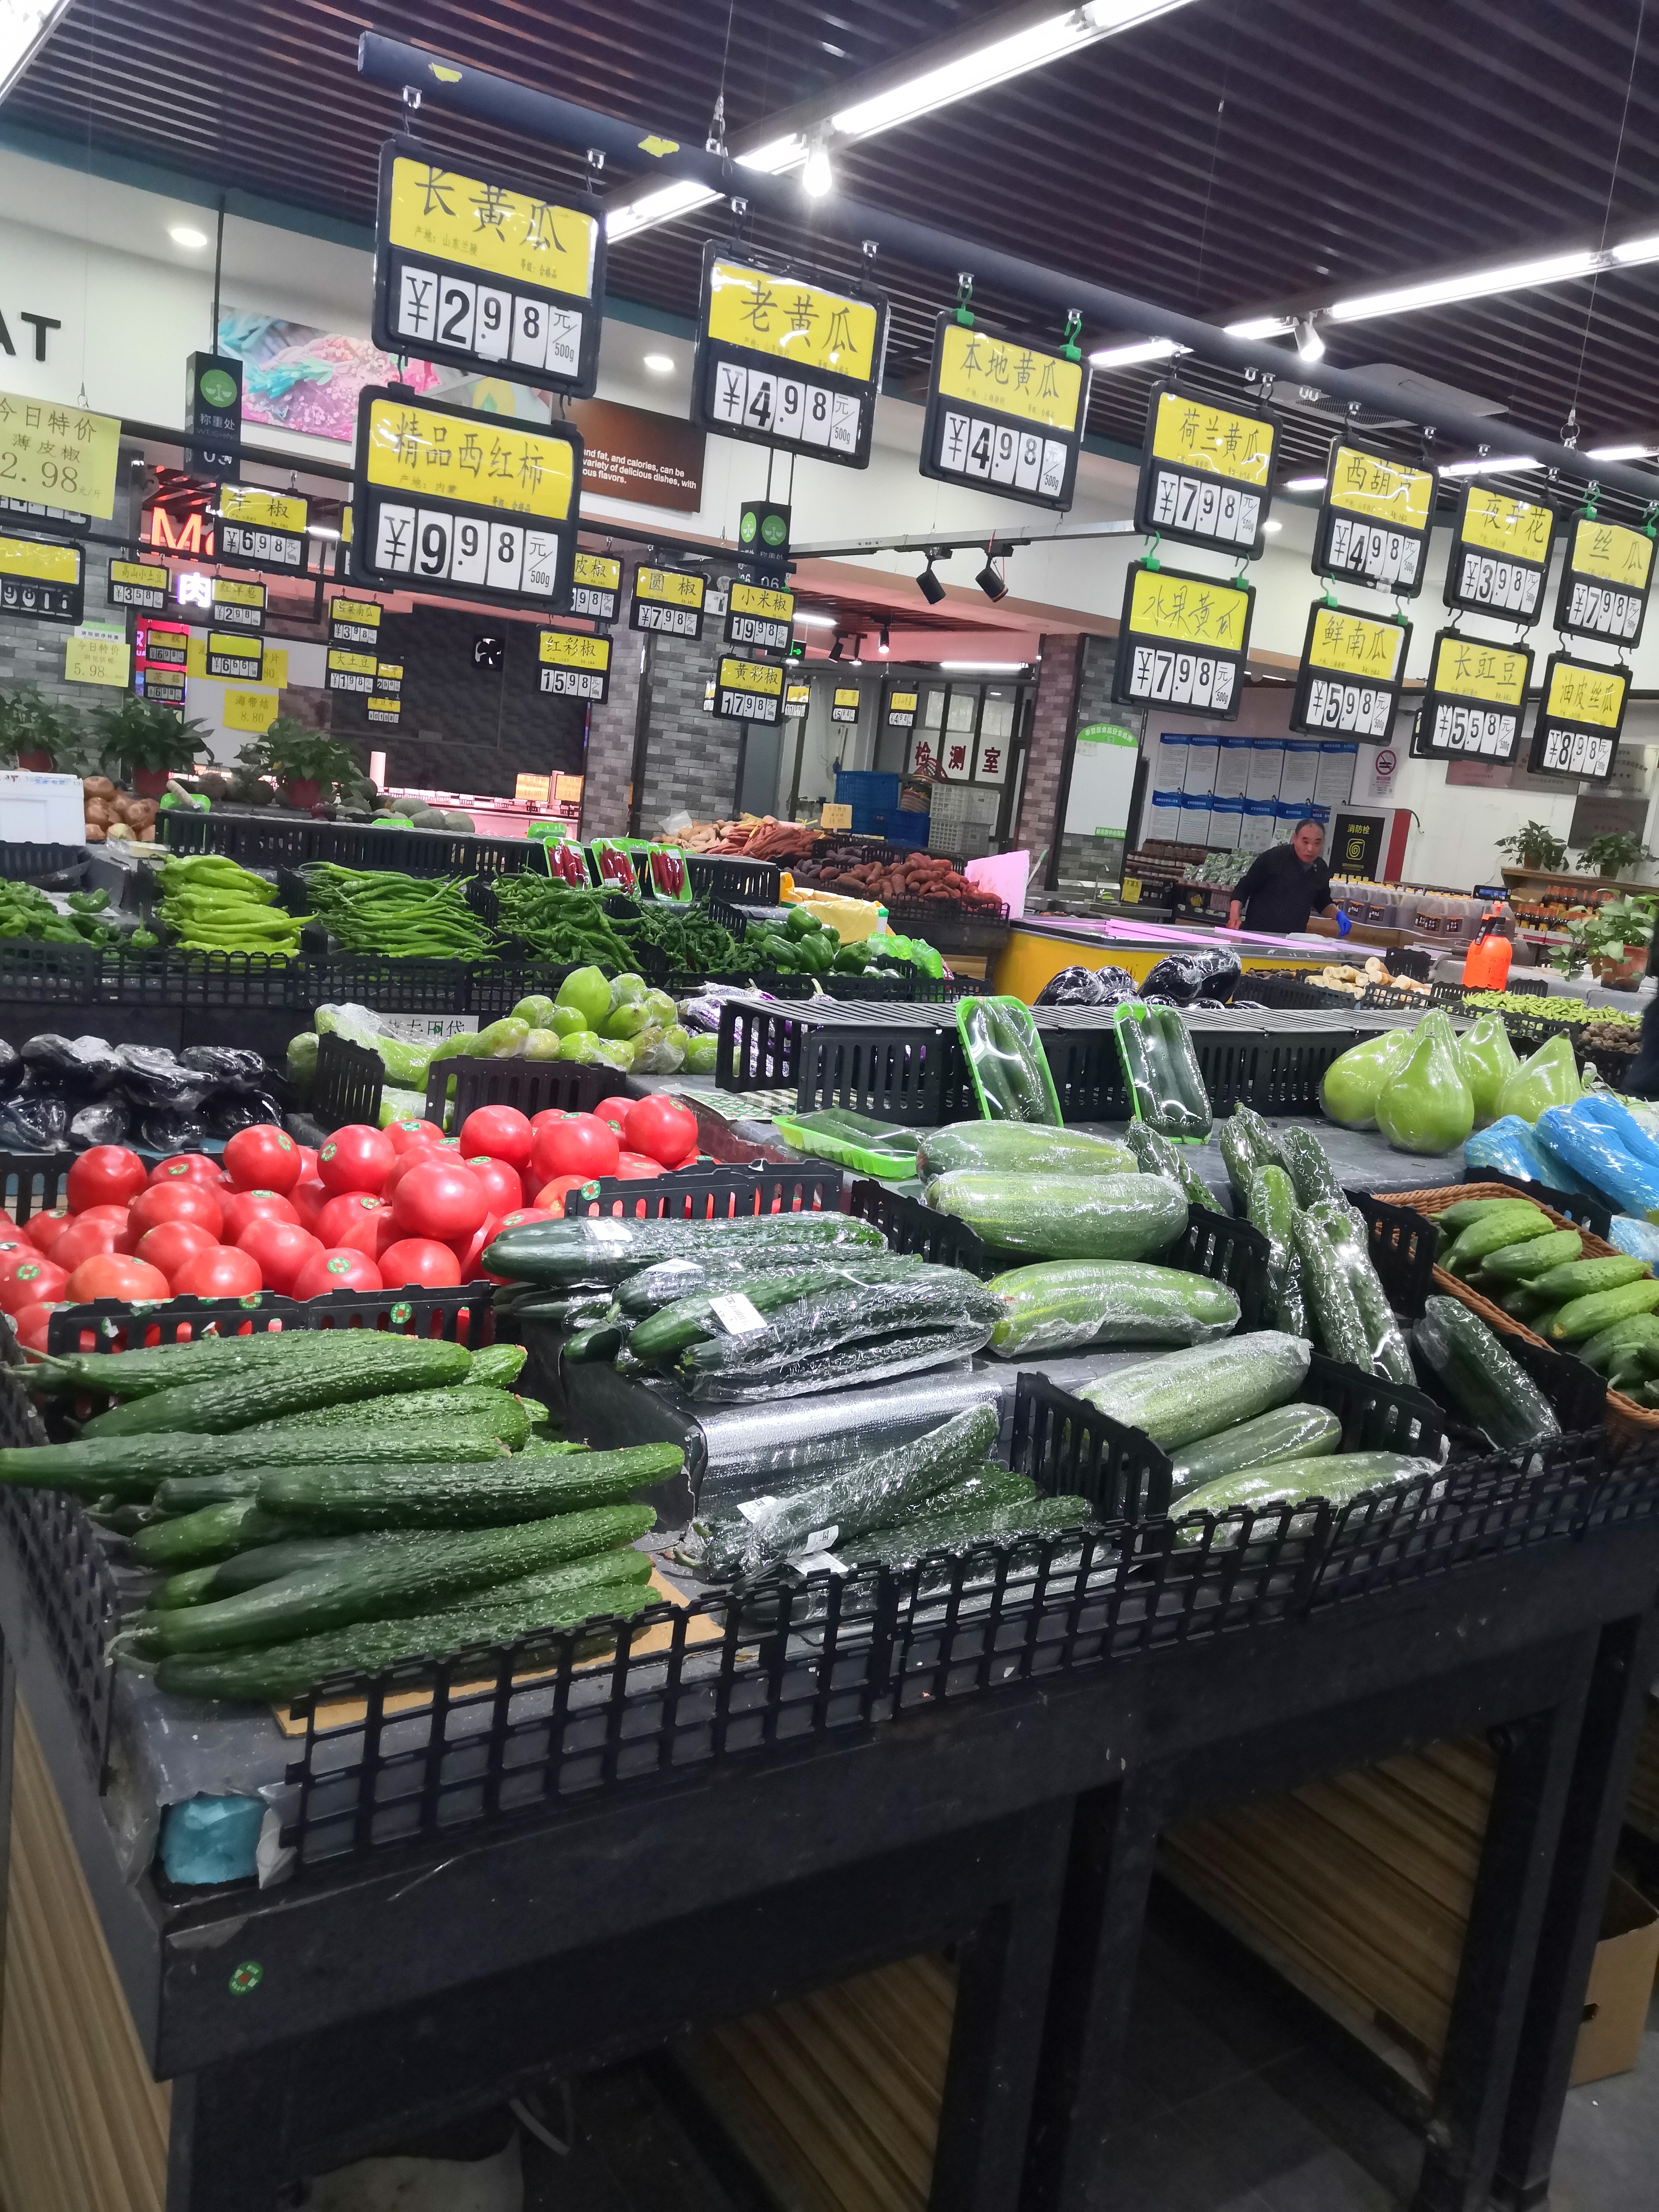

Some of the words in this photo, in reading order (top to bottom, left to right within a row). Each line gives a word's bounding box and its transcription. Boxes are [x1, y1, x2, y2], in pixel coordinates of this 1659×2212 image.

[415, 165, 567, 254] 长黄瓜
[740, 280, 858, 353] 老黄瓜
[960, 340, 1059, 399] 本地黄瓜
[0, 398, 96, 443] 今日特价
[200, 413, 235, 430] 称重处
[13, 433, 80, 463] 薄皮椒
[1179, 408, 1260, 463] 荷兰黄瓜
[392, 412, 544, 494] 精品西红柿
[597, 450, 609, 462] fat,
[611, 455, 626, 464] and
[627, 458, 658, 473] calories,
[660, 466, 673, 475] can
[675, 468, 684, 477] be
[599, 470, 627, 483] flavors.
[610, 464, 618, 472] of
[619, 466, 652, 480] delicious
[653, 472, 680, 487] dishes,
[682, 480, 696, 489] with
[1482, 493, 1545, 543] 夜开花
[1589, 528, 1642, 570] 丝瓜
[178, 572, 211, 607] 肉
[649, 573, 697, 596] 圆椒
[741, 588, 787, 611] 小米椒
[735, 618, 774, 639] 19.98
[1142, 585, 1239, 645] 水果黄瓜
[547, 636, 596, 657] 红彩椒
[1322, 616, 1386, 661] 鲜南瓜
[337, 653, 370, 668] 大土豆
[734, 663, 779, 685] 黄彩椒
[543, 671, 588, 692] 15.98
[725, 696, 763, 714] 17.98
[915, 741, 1001, 774] 检测室
[1348, 824, 1370, 835] 消防栓
